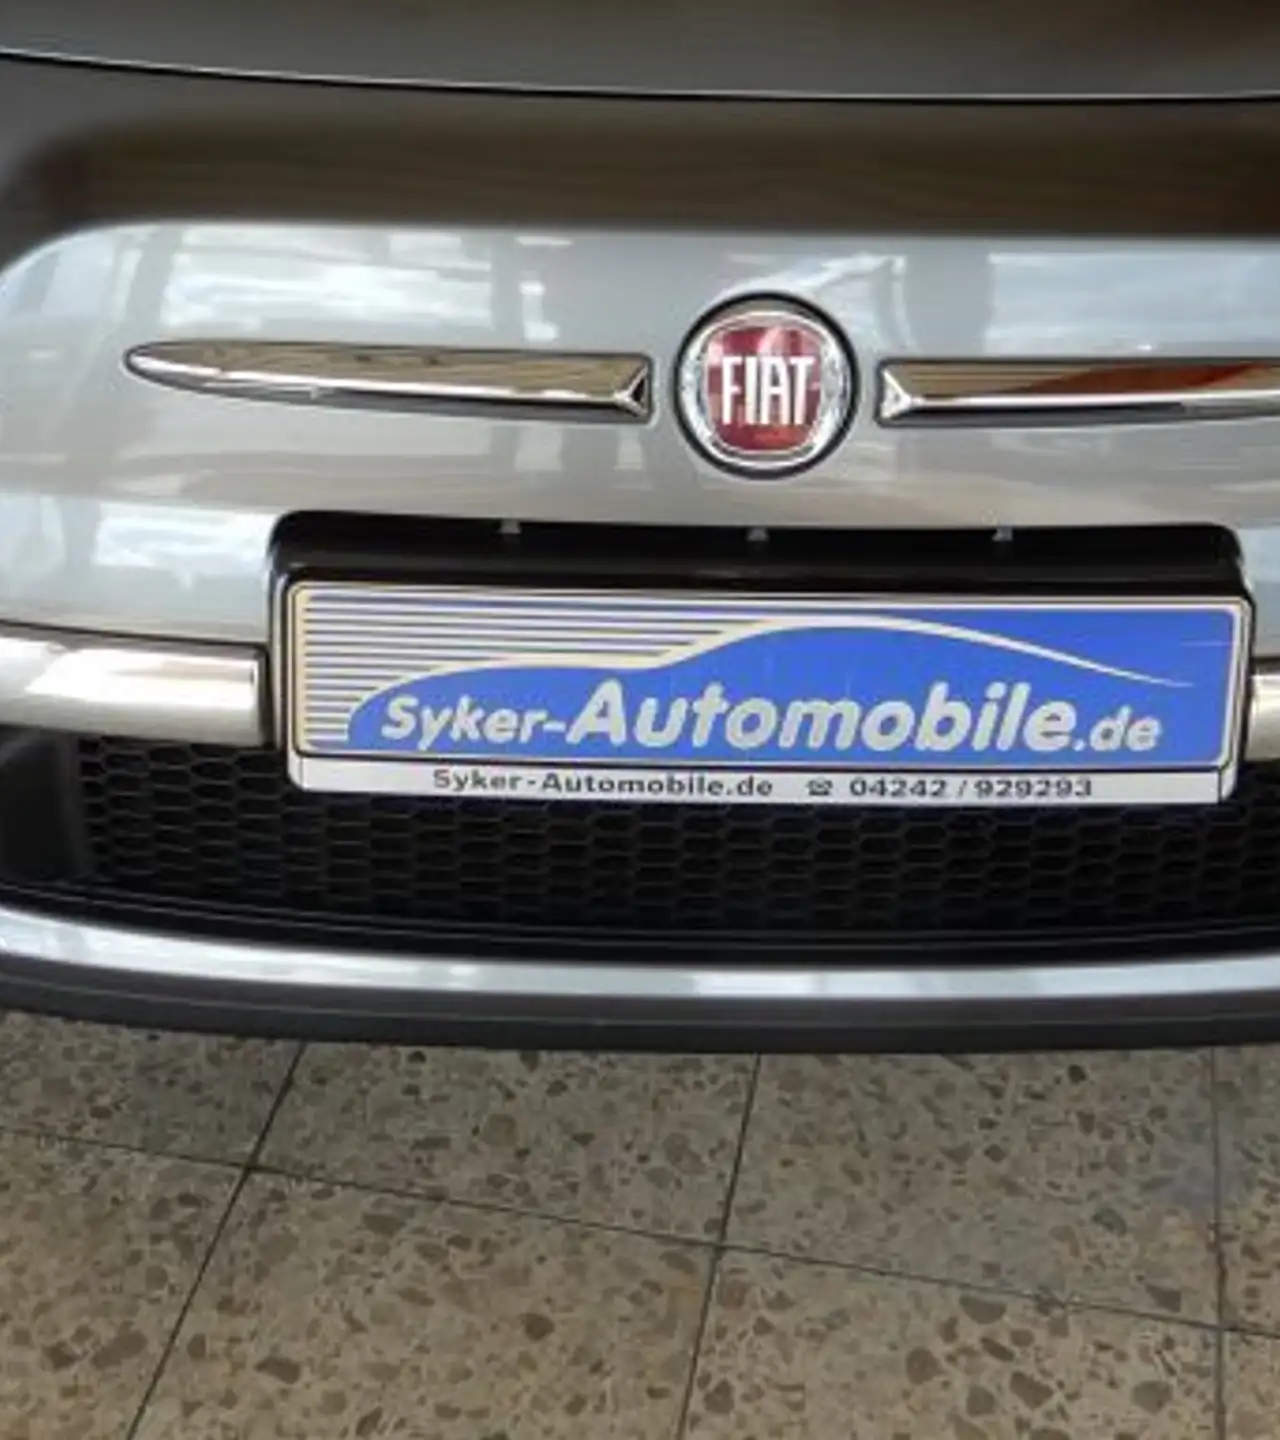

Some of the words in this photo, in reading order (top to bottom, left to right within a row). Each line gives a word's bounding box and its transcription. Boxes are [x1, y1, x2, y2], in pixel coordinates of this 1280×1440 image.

[721, 356, 816, 426] FIAT
[381, 678, 1162, 752] Syker-Automobile.de
[433, 768, 773, 798] Syker-Automobile.de
[849, 775, 946, 799] 04242
[973, 777, 1093, 799] 929293
